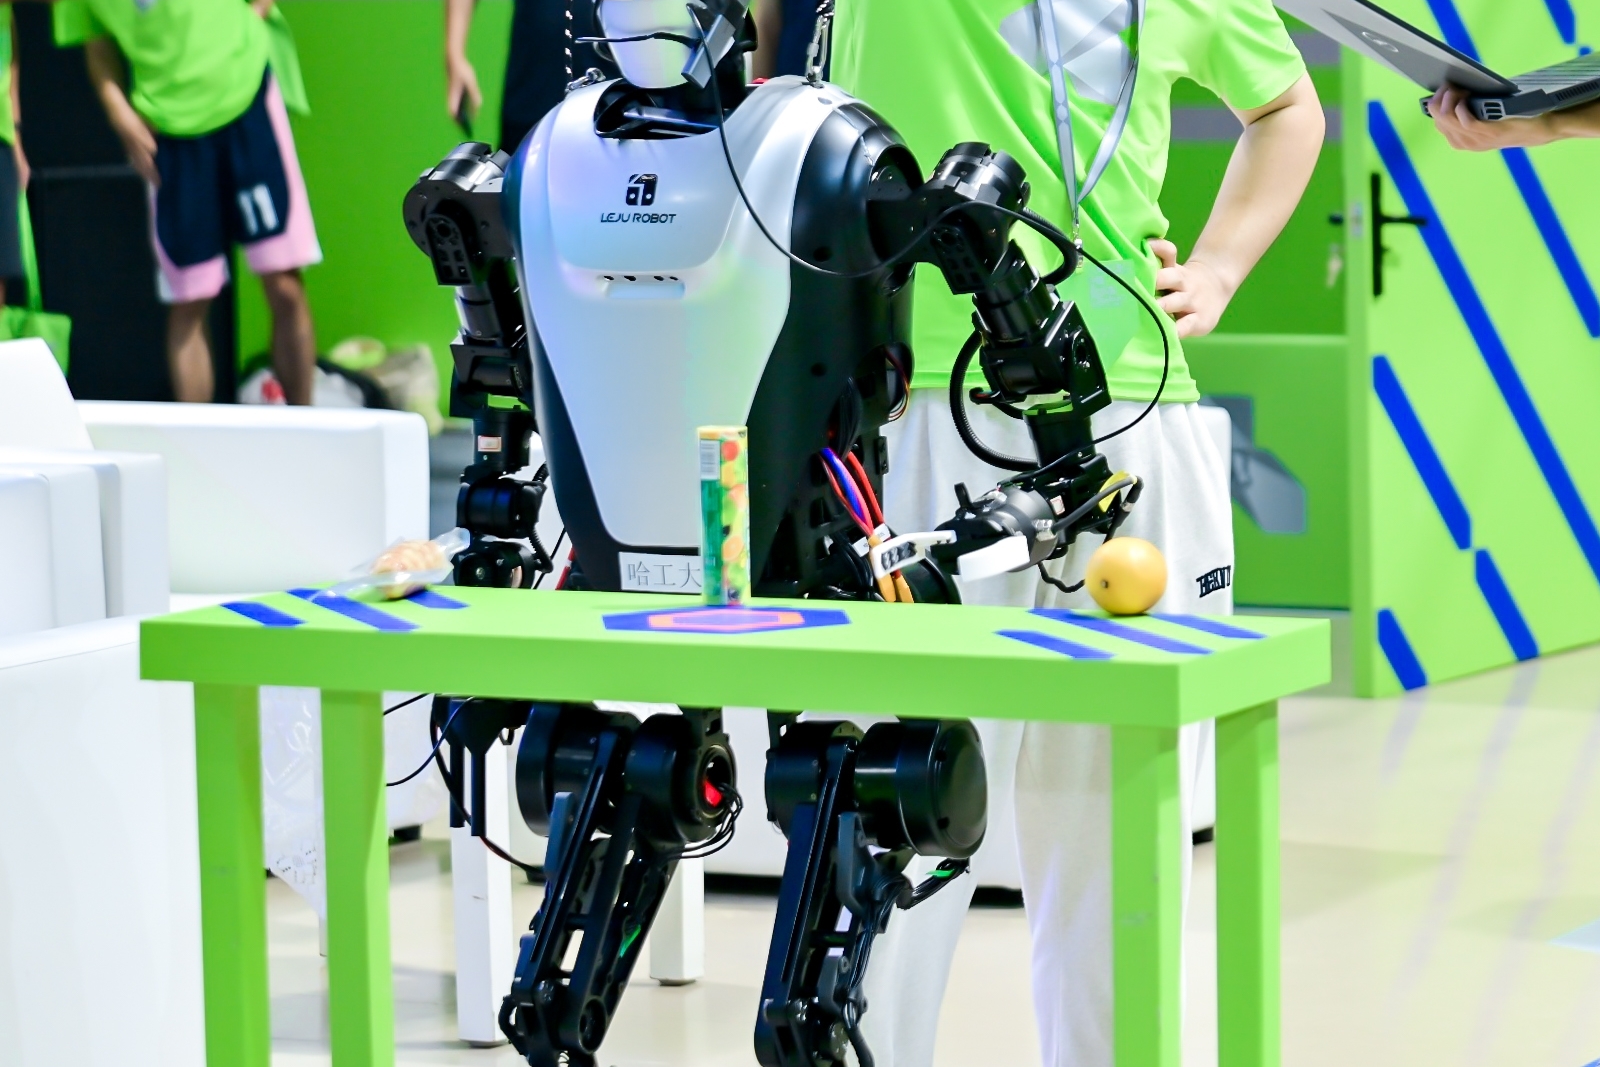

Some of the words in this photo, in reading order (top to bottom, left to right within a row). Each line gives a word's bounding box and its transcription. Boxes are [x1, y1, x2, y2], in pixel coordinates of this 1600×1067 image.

[600, 212, 631, 224] LEJU
[632, 212, 677, 224] ROBOT
[627, 560, 702, 589] 哈工大
